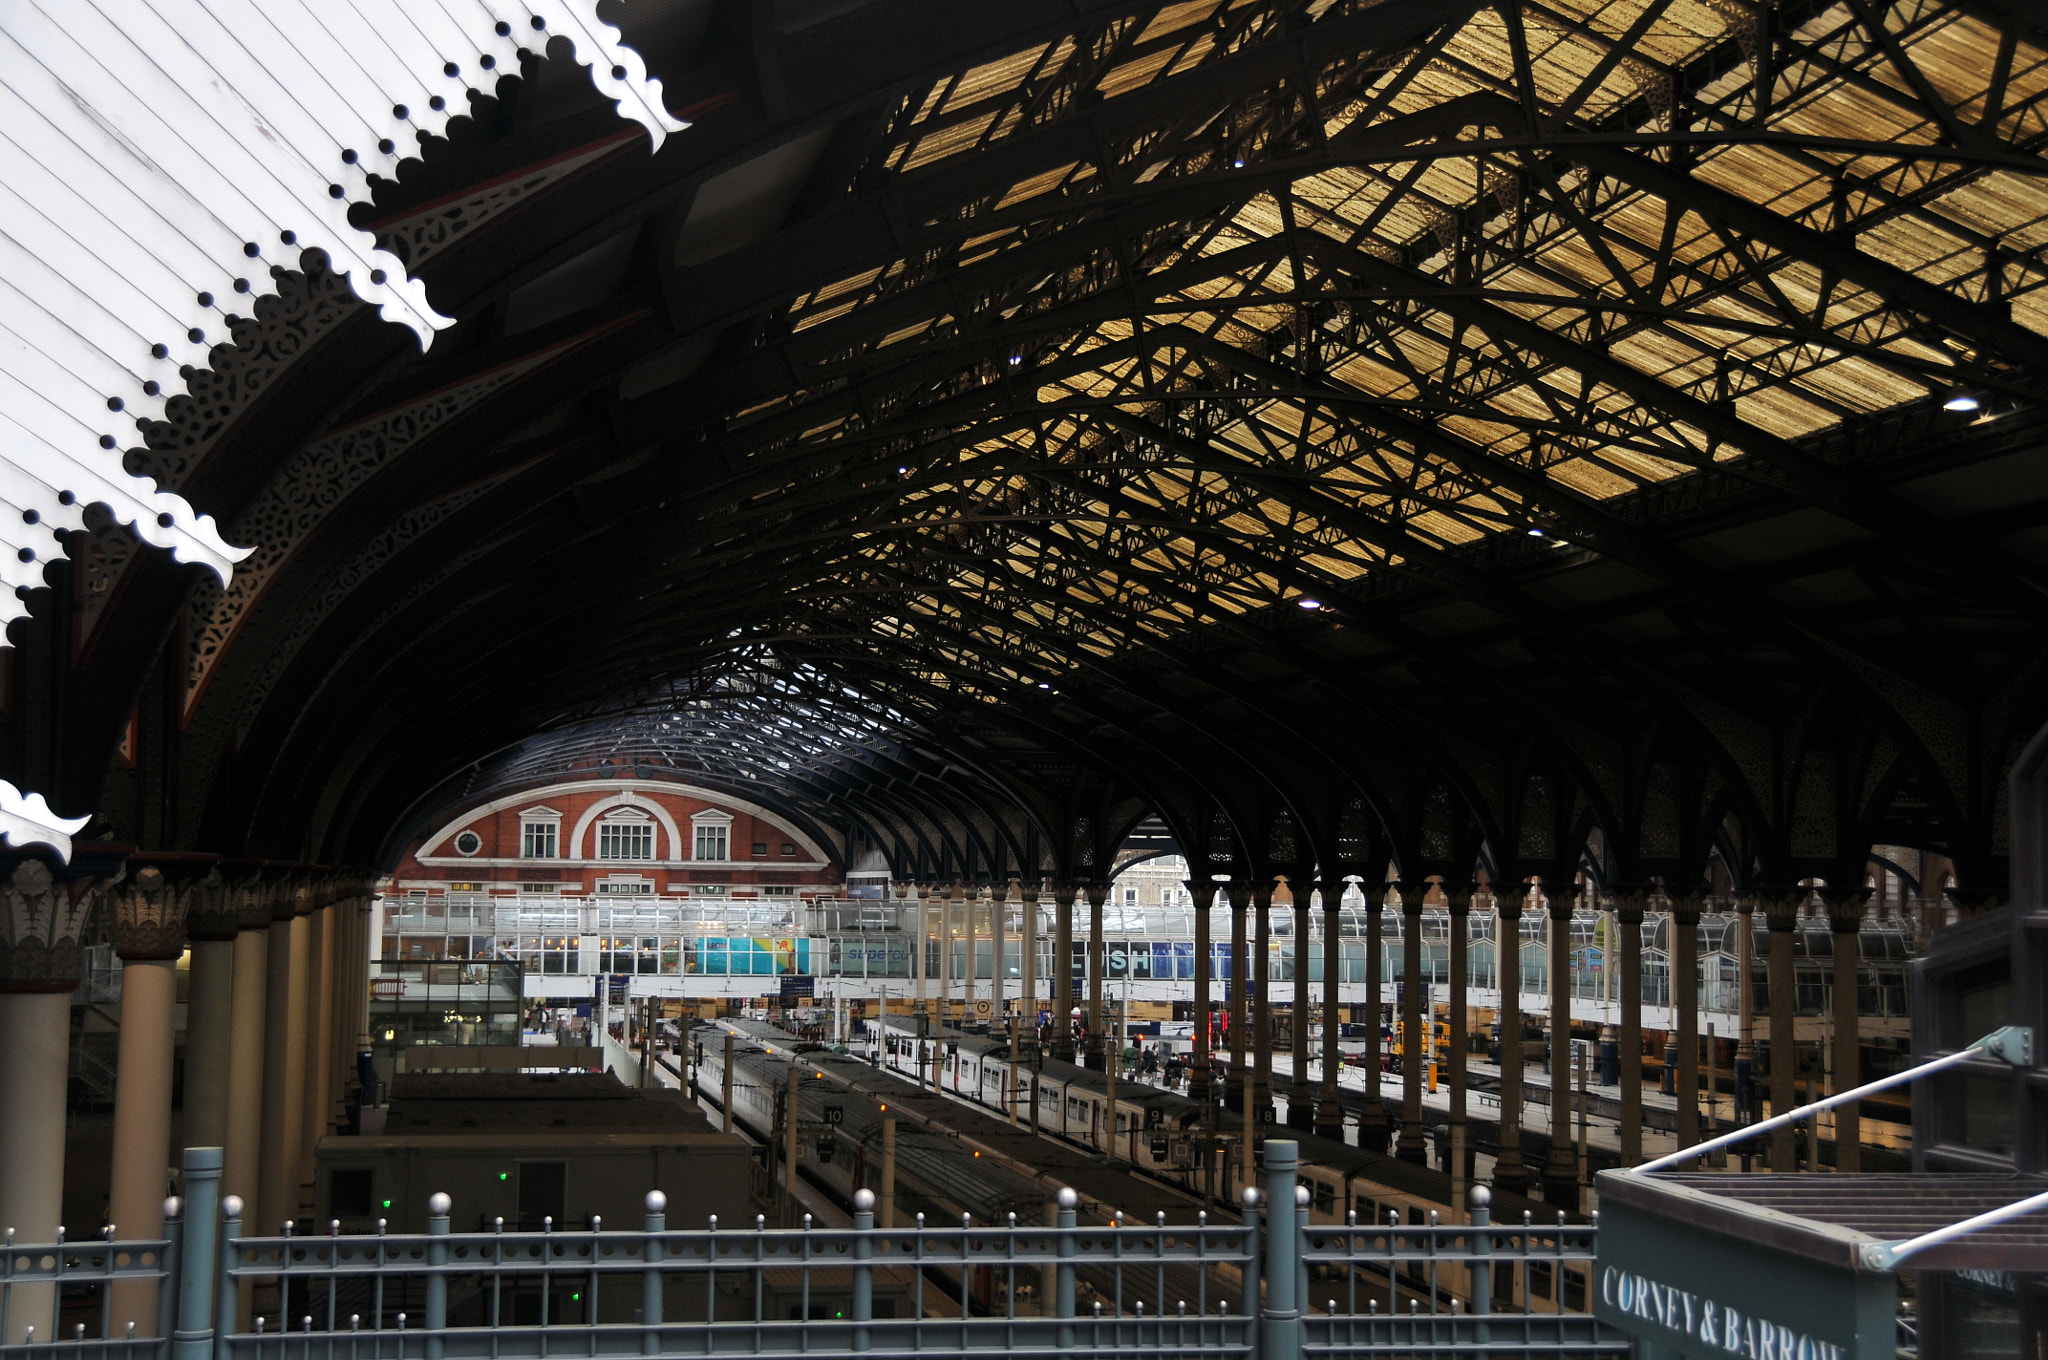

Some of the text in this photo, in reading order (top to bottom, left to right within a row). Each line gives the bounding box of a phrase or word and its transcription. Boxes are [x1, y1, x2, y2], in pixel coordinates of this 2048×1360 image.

[1071, 949, 1149, 970] LSH
[827, 1110, 842, 1122] 10
[1151, 1110, 1160, 1122] 9
[1263, 1110, 1273, 1122] 8
[1602, 1265, 1698, 1336] CORNEY
[1699, 1298, 1719, 1345] &
